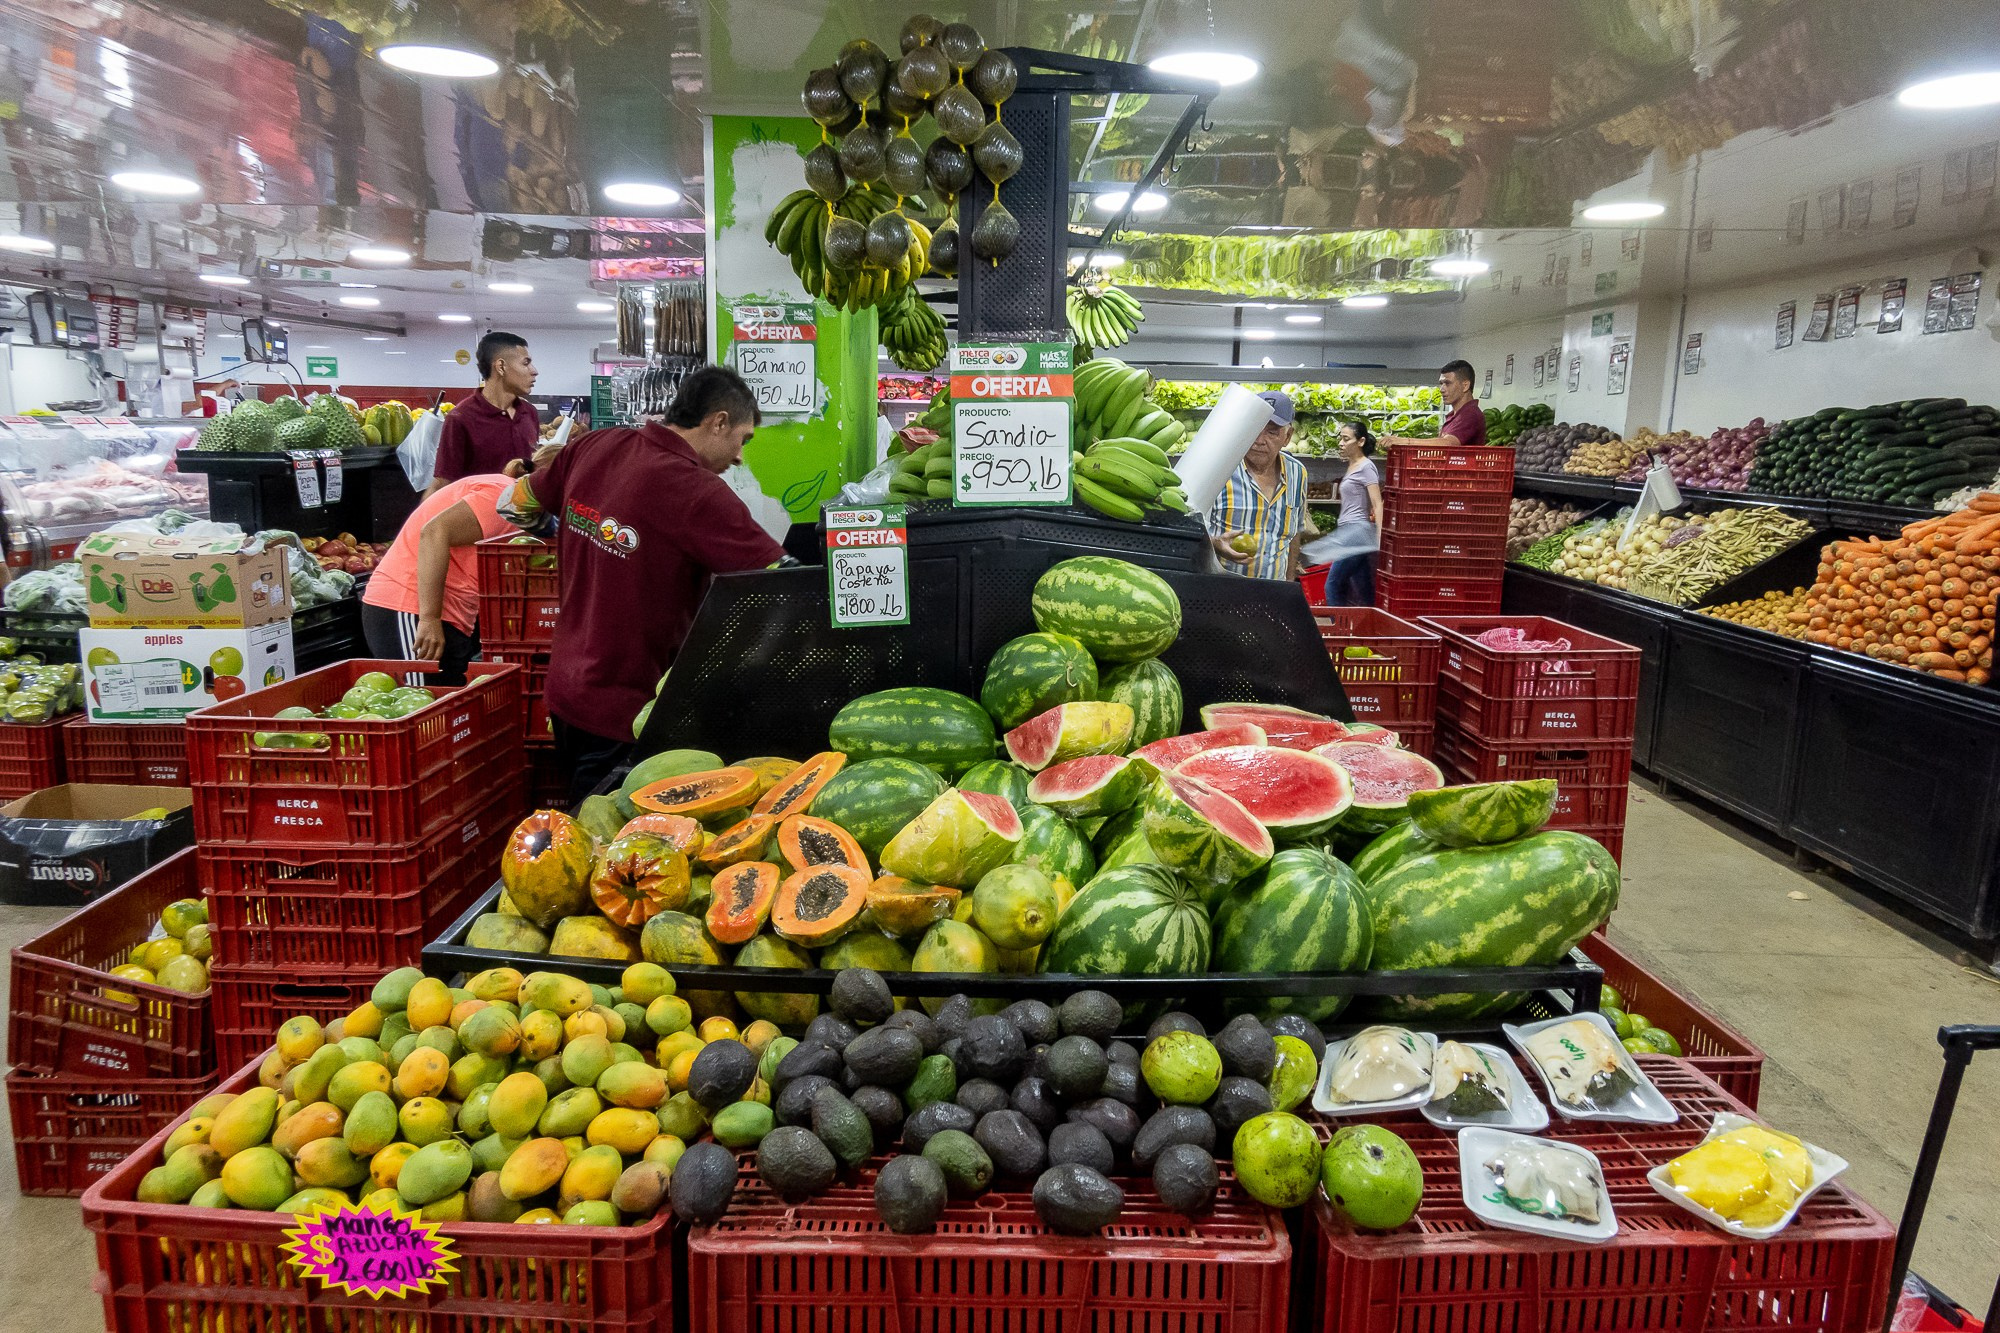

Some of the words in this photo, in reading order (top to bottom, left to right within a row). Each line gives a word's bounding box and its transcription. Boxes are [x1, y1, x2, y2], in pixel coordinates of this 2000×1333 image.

[748, 326, 802, 339] OFERTA
[959, 350, 989, 358] merca
[959, 356, 989, 364] fresca
[740, 351, 806, 374] Banano
[971, 376, 1052, 396] OFERTA
[960, 408, 1010, 417] PRODUCTO:
[963, 421, 1056, 450] Sandia
[960, 452, 994, 460] PRECIO:
[836, 530, 898, 546] OFERTA
[836, 559, 896, 580] Papaya
[142, 579, 174, 593] Dole
[144, 634, 183, 646] apples
[277, 800, 318, 809] MERCA
[274, 816, 323, 826] FRESCA
[87, 1043, 128, 1059] MERCA
[82, 1054, 130, 1071] FRESCA
